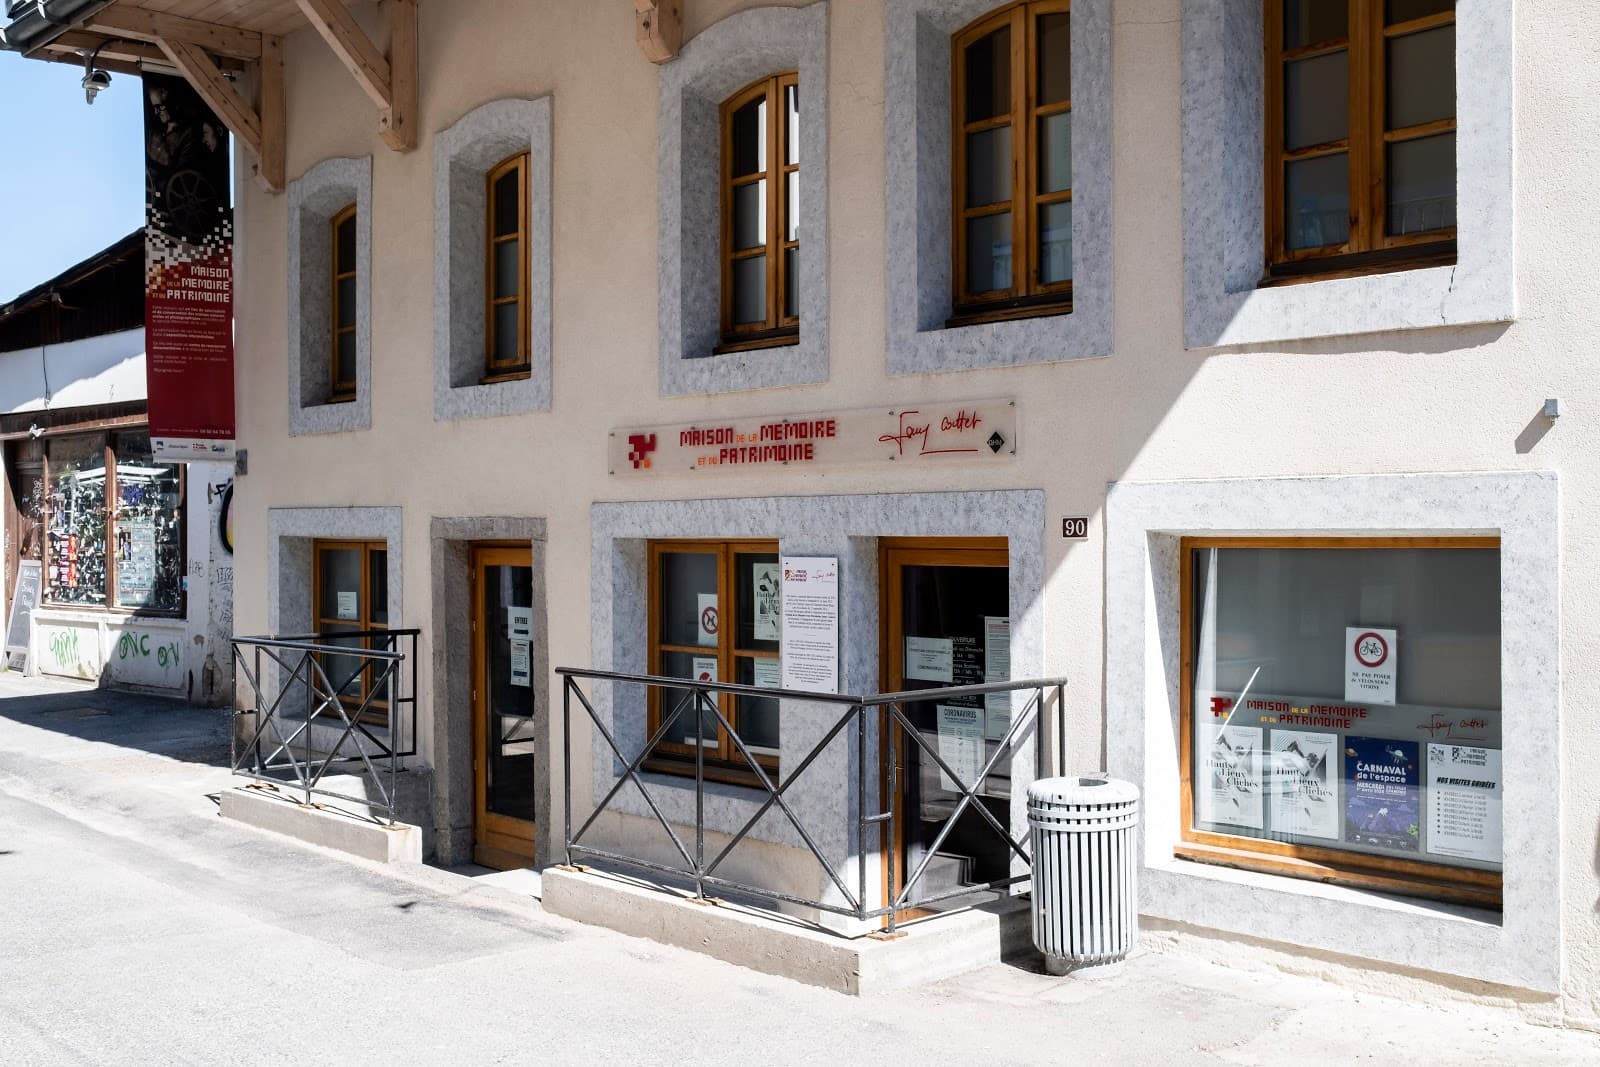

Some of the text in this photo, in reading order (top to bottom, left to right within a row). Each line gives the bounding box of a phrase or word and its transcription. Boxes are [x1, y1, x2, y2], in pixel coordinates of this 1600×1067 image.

[191, 266, 229, 278] MAISON
[182, 278, 229, 290] MEMOIRE
[167, 290, 229, 302] PATRIMOINE
[680, 420, 836, 447] MAISON DE LA MEMOIRE
[697, 457, 706, 465] ET
[720, 443, 814, 464] PATRIMOINE
[1065, 520, 1085, 536] 90
[944, 708, 977, 719] CORONAVIRUS
[1247, 700, 1290, 712] MAISON
[1310, 704, 1368, 719] MEMOIRE
[1279, 714, 1351, 728] PATRIMOINE
[1357, 763, 1406, 775] CARNAVAL
[1370, 773, 1406, 783] l'espace
[1437, 777, 1449, 785] NOS
[1449, 778, 1470, 787] VISITES
